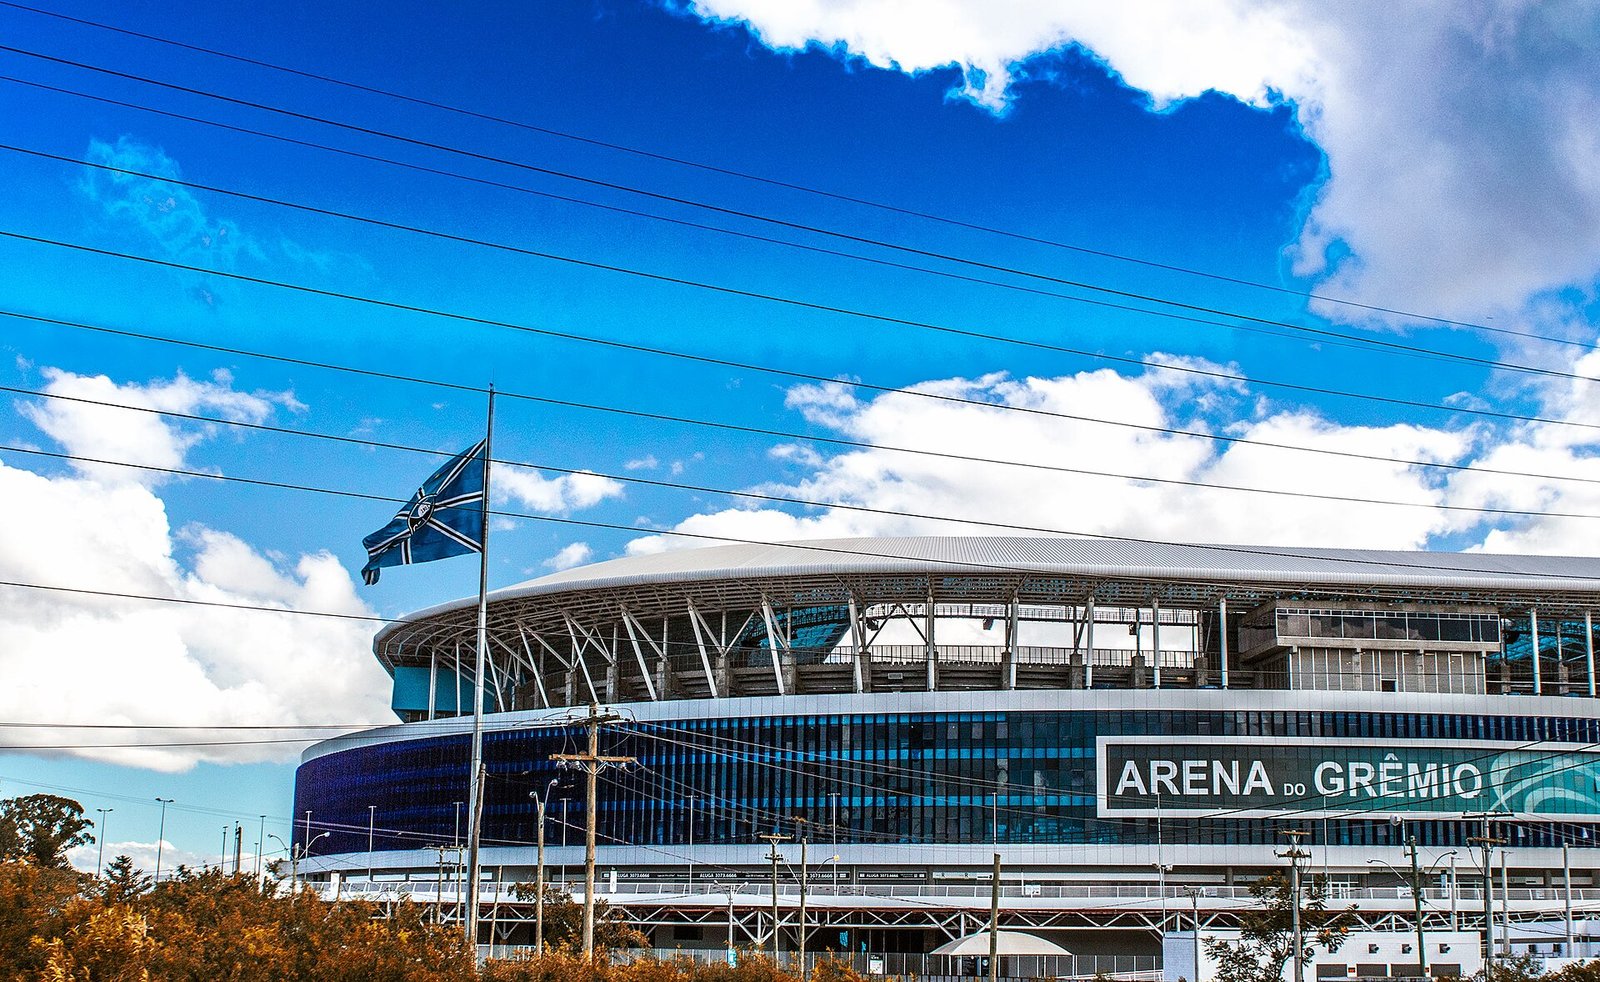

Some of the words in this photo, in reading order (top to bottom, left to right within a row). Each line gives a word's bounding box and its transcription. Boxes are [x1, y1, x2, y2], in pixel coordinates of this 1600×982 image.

[1115, 760, 1274, 796] ARENA
[1283, 782, 1306, 797] DO
[1314, 753, 1482, 800] GRÊMIO
